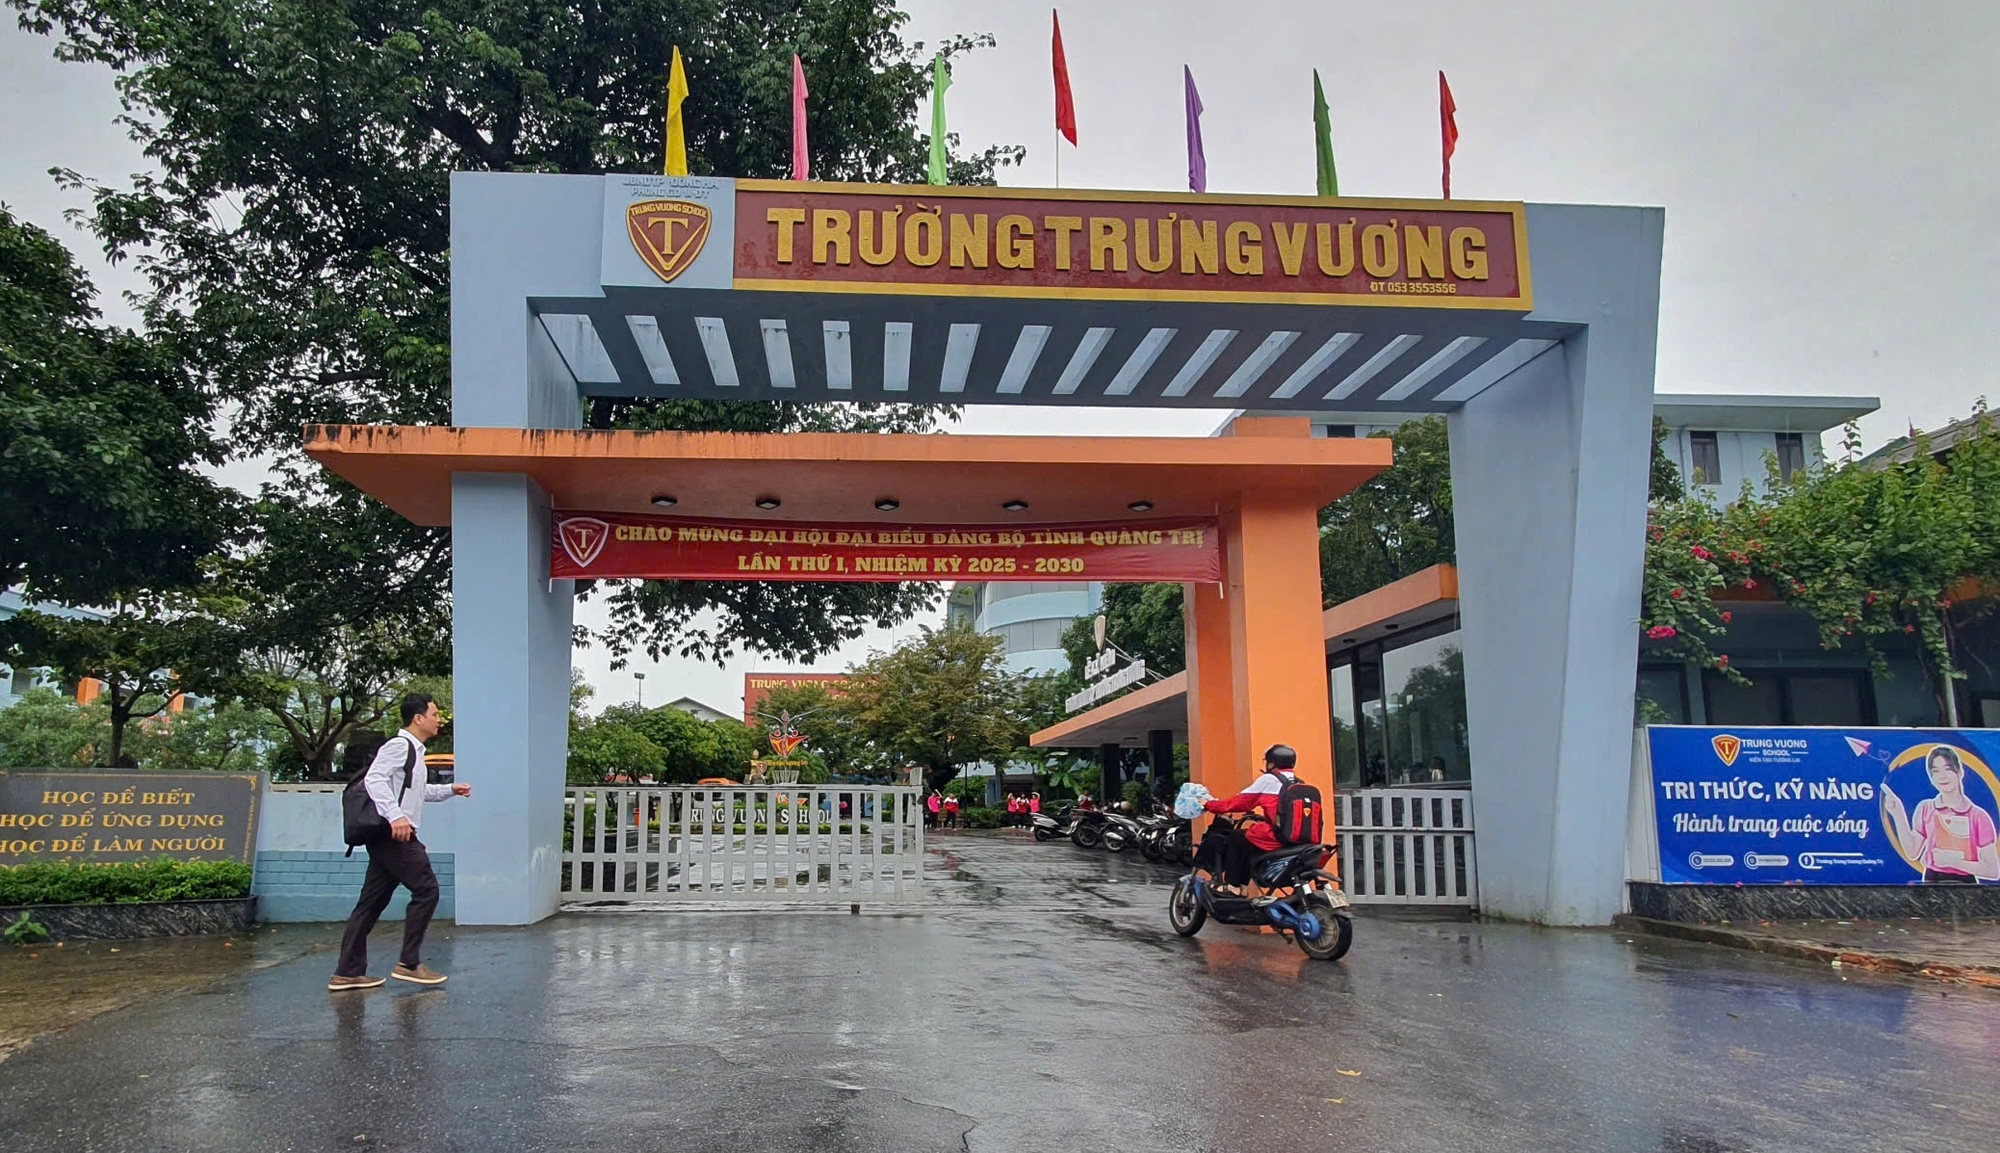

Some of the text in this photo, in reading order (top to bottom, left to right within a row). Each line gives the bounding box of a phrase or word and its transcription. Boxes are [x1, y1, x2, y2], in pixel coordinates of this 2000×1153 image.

[630, 203, 708, 218] TRUNG VUONG SCHOOL
[767, 203, 1489, 280] TRƯỜNG TRƯNG VƯƠNG
[1387, 282, 1408, 293] 053
[1409, 282, 1456, 294] 3553556
[615, 523, 672, 542] CHÀO
[678, 525, 743, 542] MỪNG
[749, 529, 787, 546] ĐẠI
[793, 528, 830, 547] HỘI
[835, 531, 872, 547] ĐẠI
[878, 526, 926, 544] BIỂU
[932, 528, 992, 545] ĐẢNG
[997, 529, 1026, 548] BỘ
[1031, 527, 1084, 545] TỈNH
[1090, 526, 1162, 546] QUẢNG
[1168, 529, 1204, 549] TRỊ
[738, 551, 781, 571] LẦN
[787, 553, 832, 572] THỨ
[836, 556, 849, 575] I,
[855, 553, 928, 576] NHIỆM
[933, 554, 963, 573] KỲ
[968, 557, 1017, 573] 2025
[1035, 557, 1085, 573] 2030
[1741, 738, 1808, 749] TRUNG VUONG
[1762, 749, 1790, 757] SCHOOL
[42, 785, 195, 807] HỌC ĐỂ BIẾT
[1661, 777, 1874, 802] TRI THỨC, KỸ NĂNG
[0, 807, 225, 831] HỌC ĐỂ ỨNG DỤNG
[780, 808, 832, 824] SHOL
[1672, 811, 1870, 839] Hành trang cuộc sống
[51, 832, 88, 852] ĐỂ
[93, 835, 144, 852] LÀM
[150, 834, 226, 852] NGƯỜI
